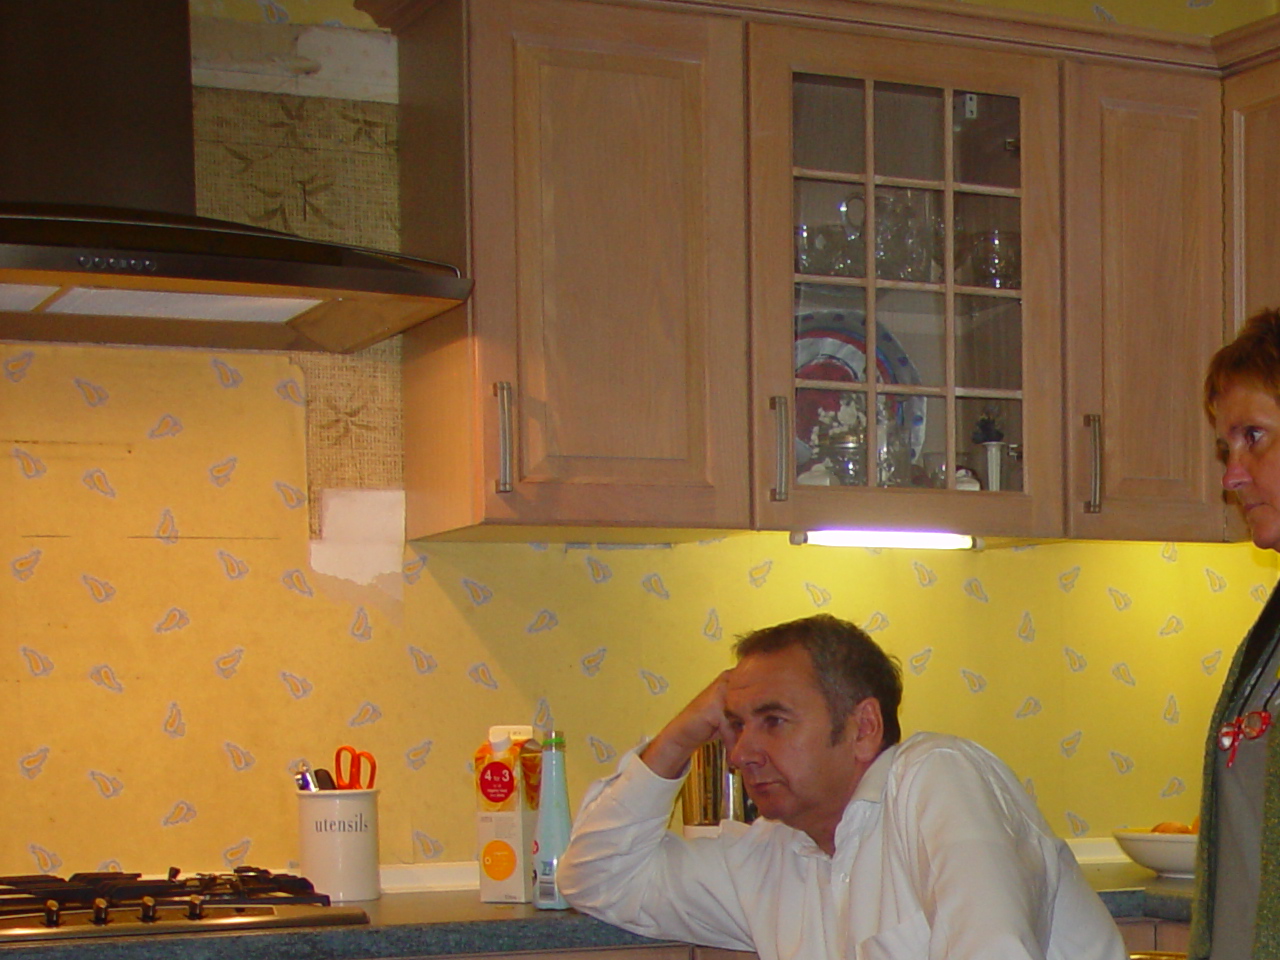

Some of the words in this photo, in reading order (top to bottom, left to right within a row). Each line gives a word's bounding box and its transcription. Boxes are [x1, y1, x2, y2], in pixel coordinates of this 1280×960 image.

[484, 769, 492, 781] 4
[501, 769, 510, 782] 3
[314, 813, 369, 833] utensils
